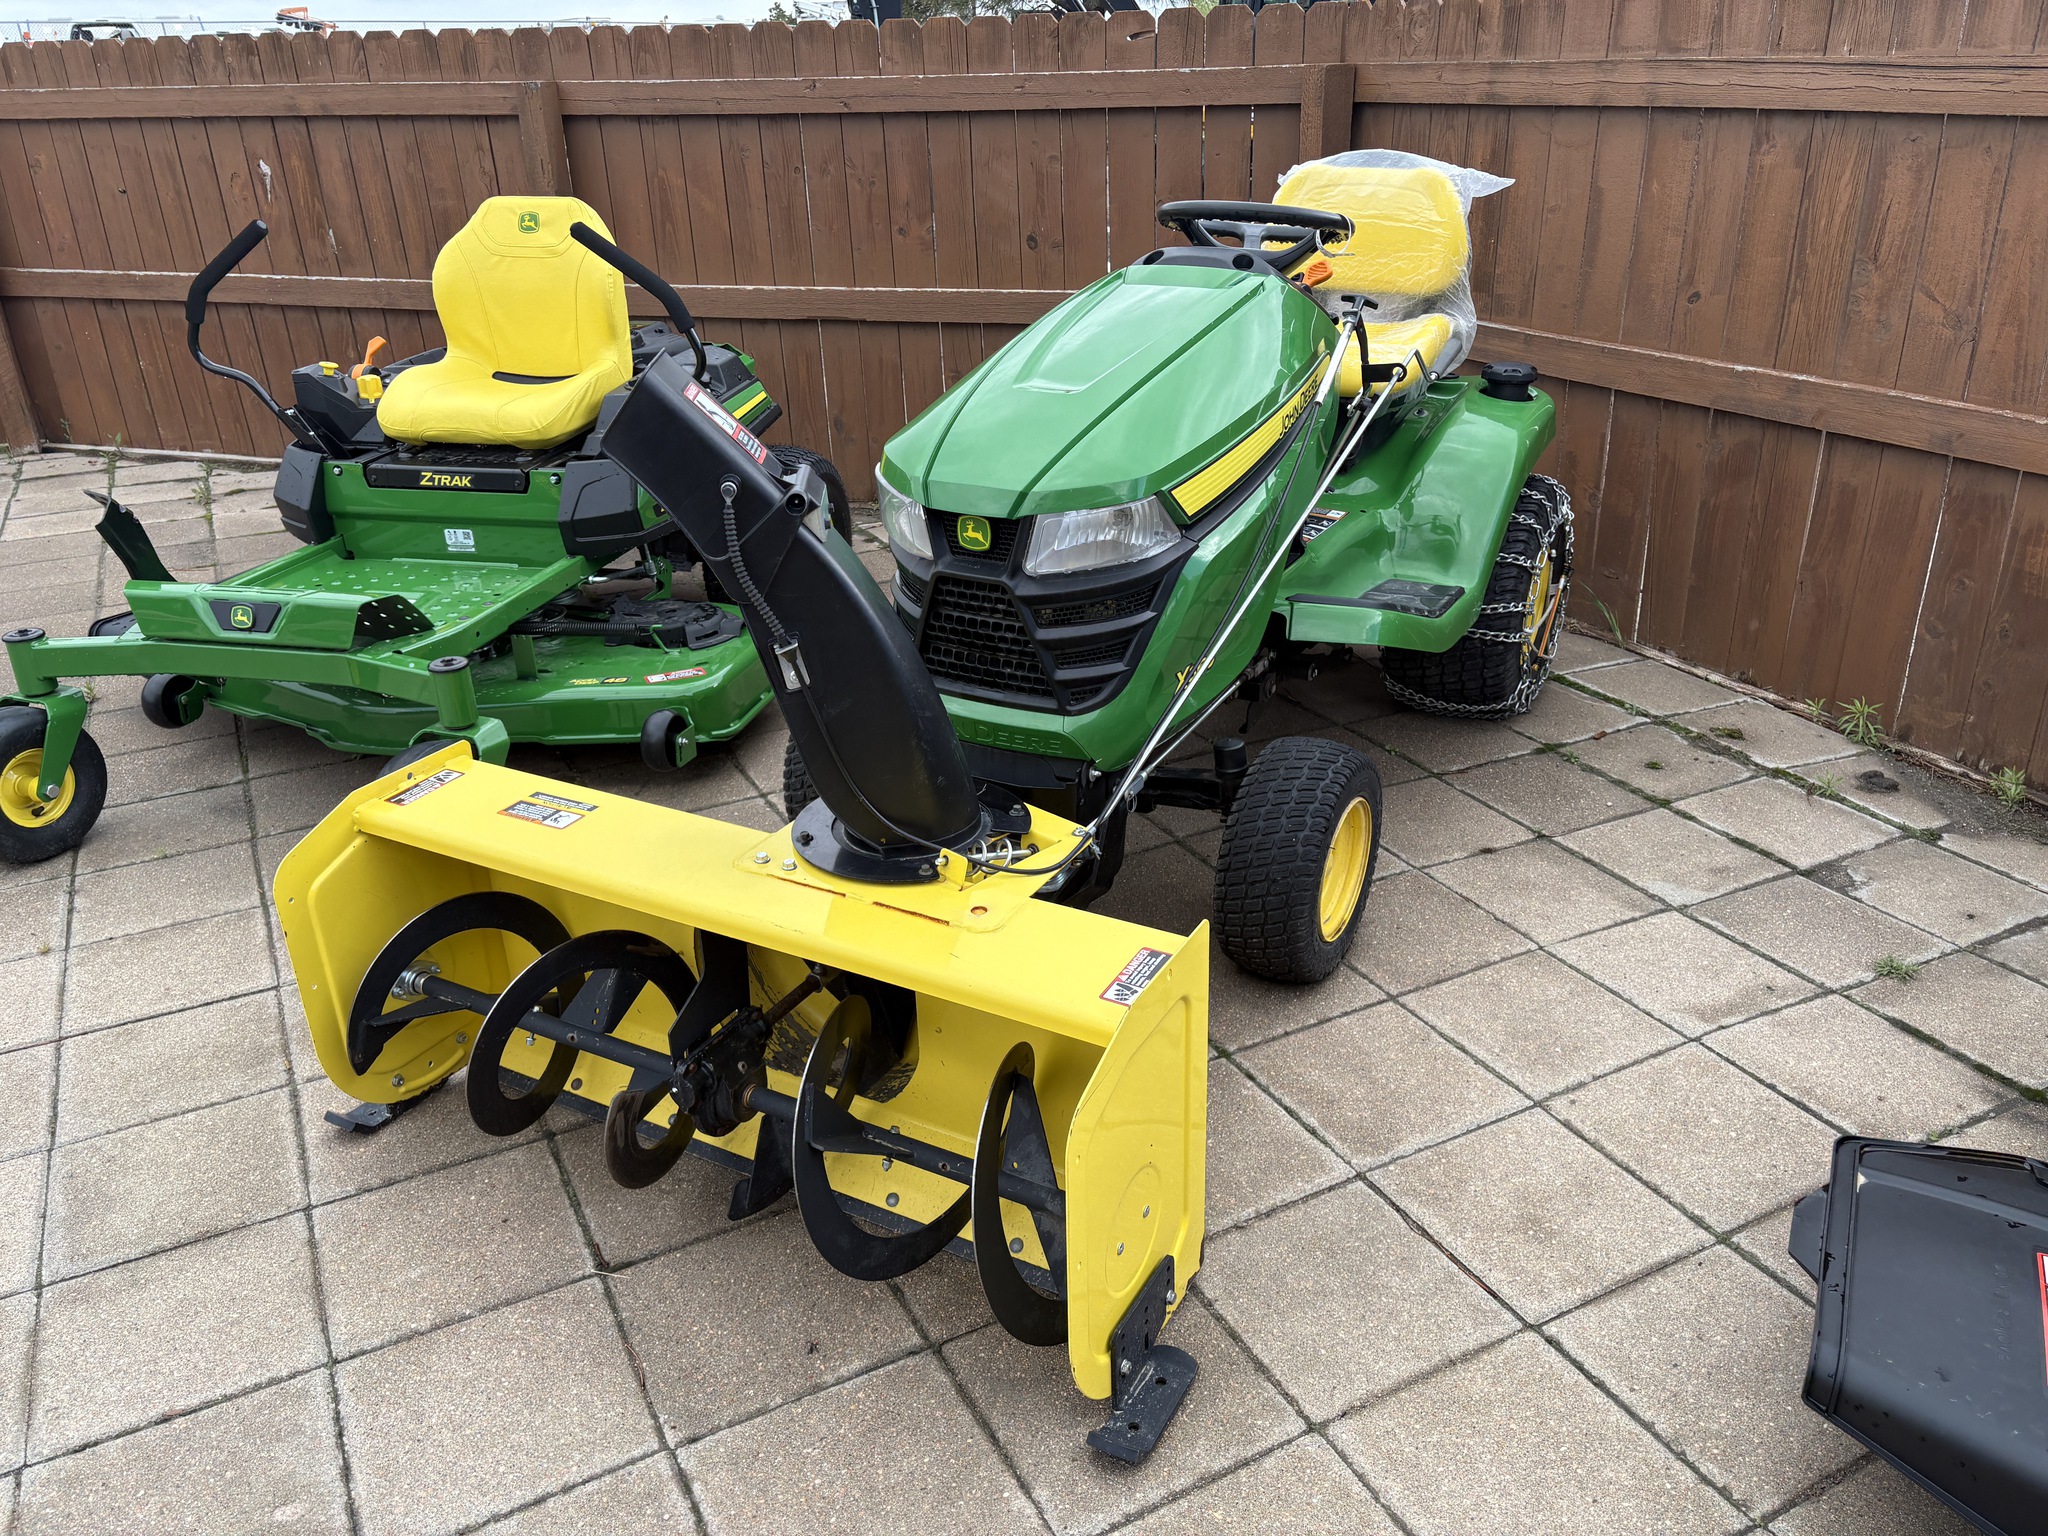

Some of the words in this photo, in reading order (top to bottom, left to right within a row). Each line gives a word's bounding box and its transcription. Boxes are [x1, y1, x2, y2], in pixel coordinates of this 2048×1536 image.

[1280, 401, 1300, 439] JOHN
[420, 471, 472, 488] ZTRAK
[974, 722, 1063, 754] DEERE
[1124, 949, 1151, 976] DANGER
